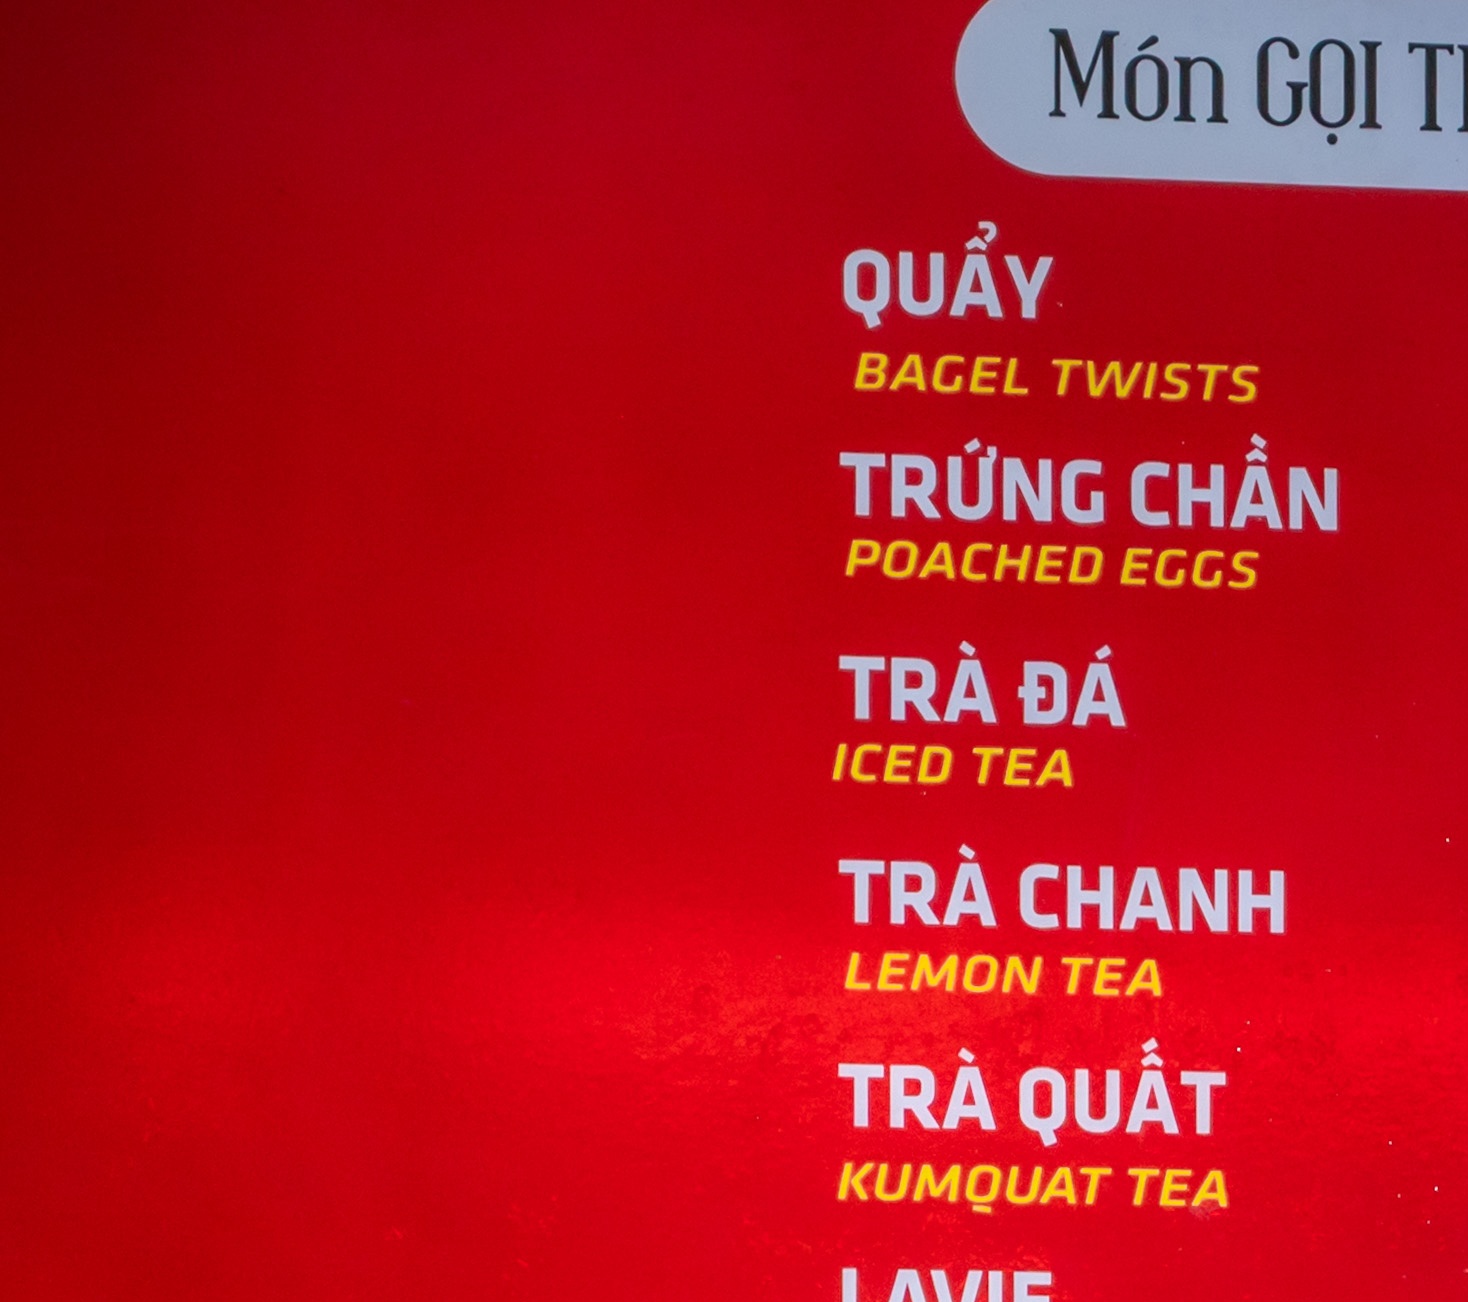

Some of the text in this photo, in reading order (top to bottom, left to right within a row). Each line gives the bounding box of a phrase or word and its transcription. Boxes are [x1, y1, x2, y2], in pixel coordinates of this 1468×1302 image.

[1049, 28, 1228, 123] Món
[1257, 37, 1382, 145] GỌI
[844, 222, 1053, 328] QUẨY
[855, 353, 1258, 402] BAGEL TWISTS
[840, 434, 1337, 530] TRỨNG CHẦN
[846, 540, 1258, 588] POACHED EGGS
[839, 641, 1125, 726] TRÀ ĐÁ
[833, 744, 1072, 786] ICED TEA
[839, 844, 1284, 933] TRÀ CHANH
[845, 952, 1162, 996] LEMON TEA
[838, 1038, 1226, 1146] TRÀ QUẤT
[838, 1162, 1227, 1213] KUMQUAT TEA
